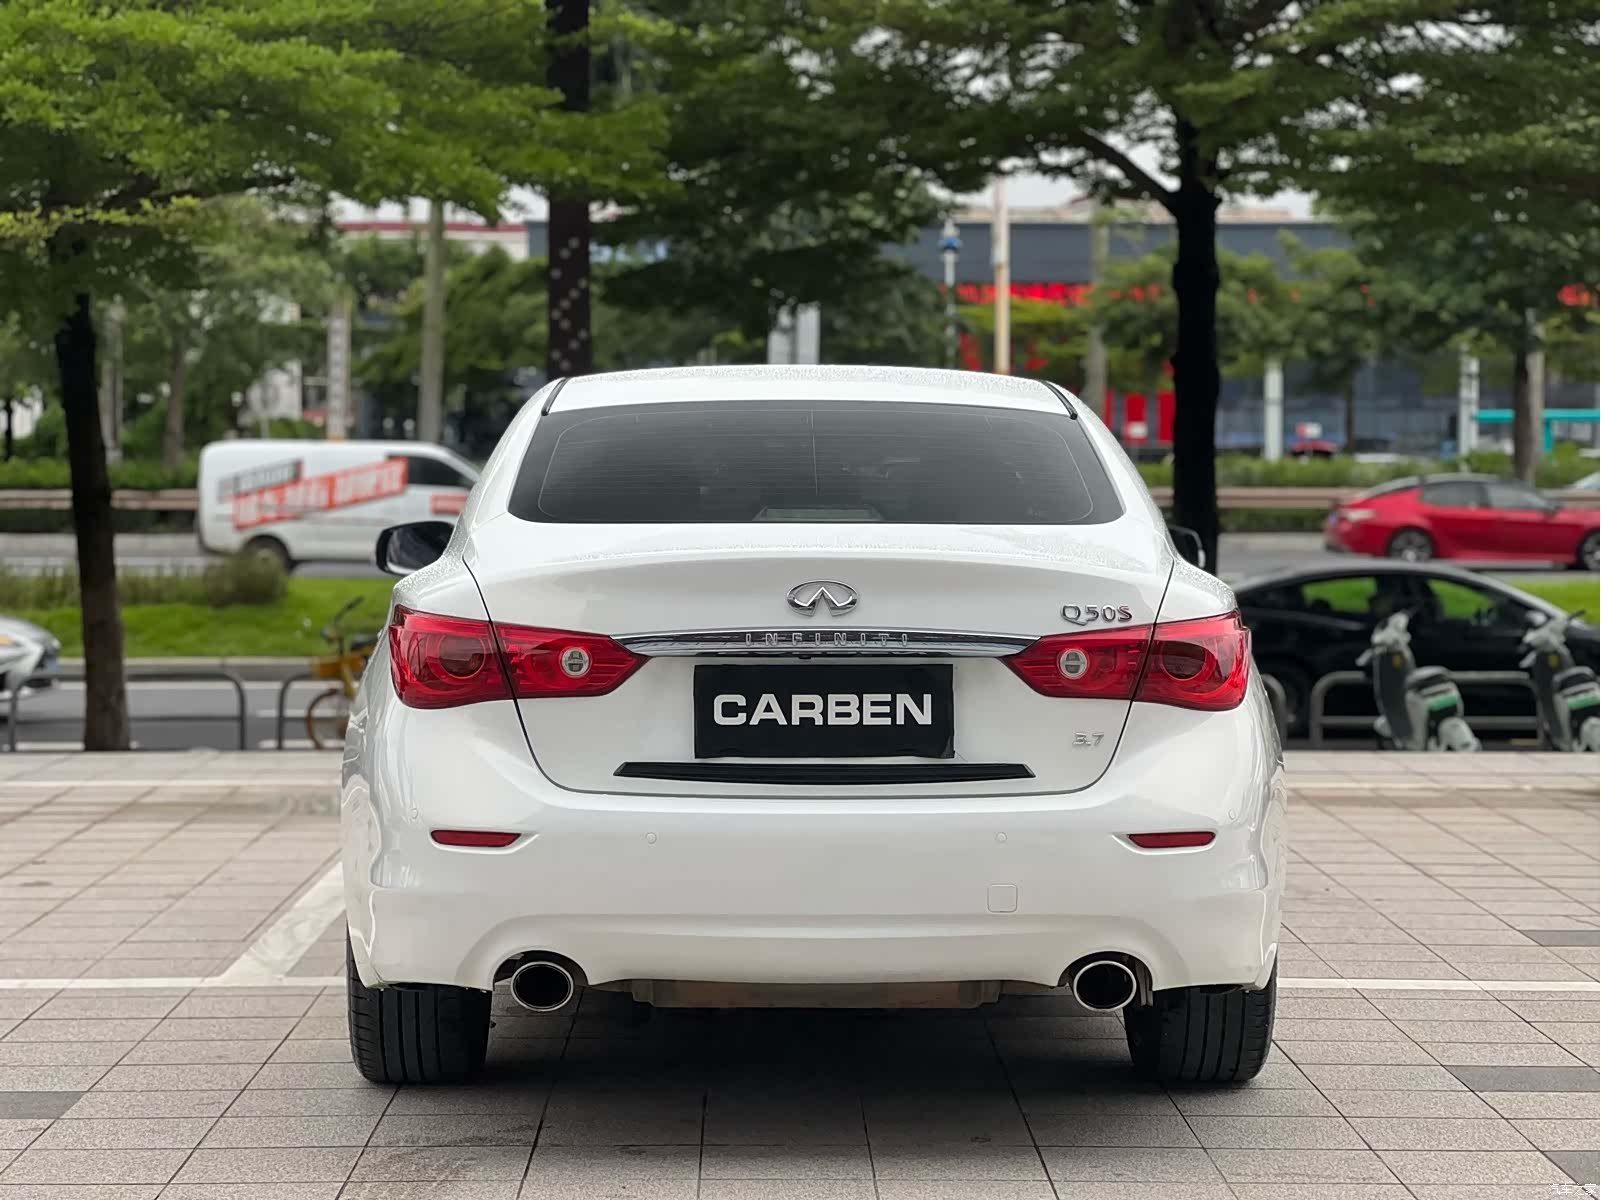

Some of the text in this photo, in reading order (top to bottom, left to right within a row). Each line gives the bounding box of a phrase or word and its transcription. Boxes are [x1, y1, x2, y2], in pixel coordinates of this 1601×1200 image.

[1061, 604, 1133, 626] Q50S
[745, 631, 909, 647] INFINITI
[713, 693, 932, 726] CARBEN
[1072, 732, 1104, 746] 3.7
